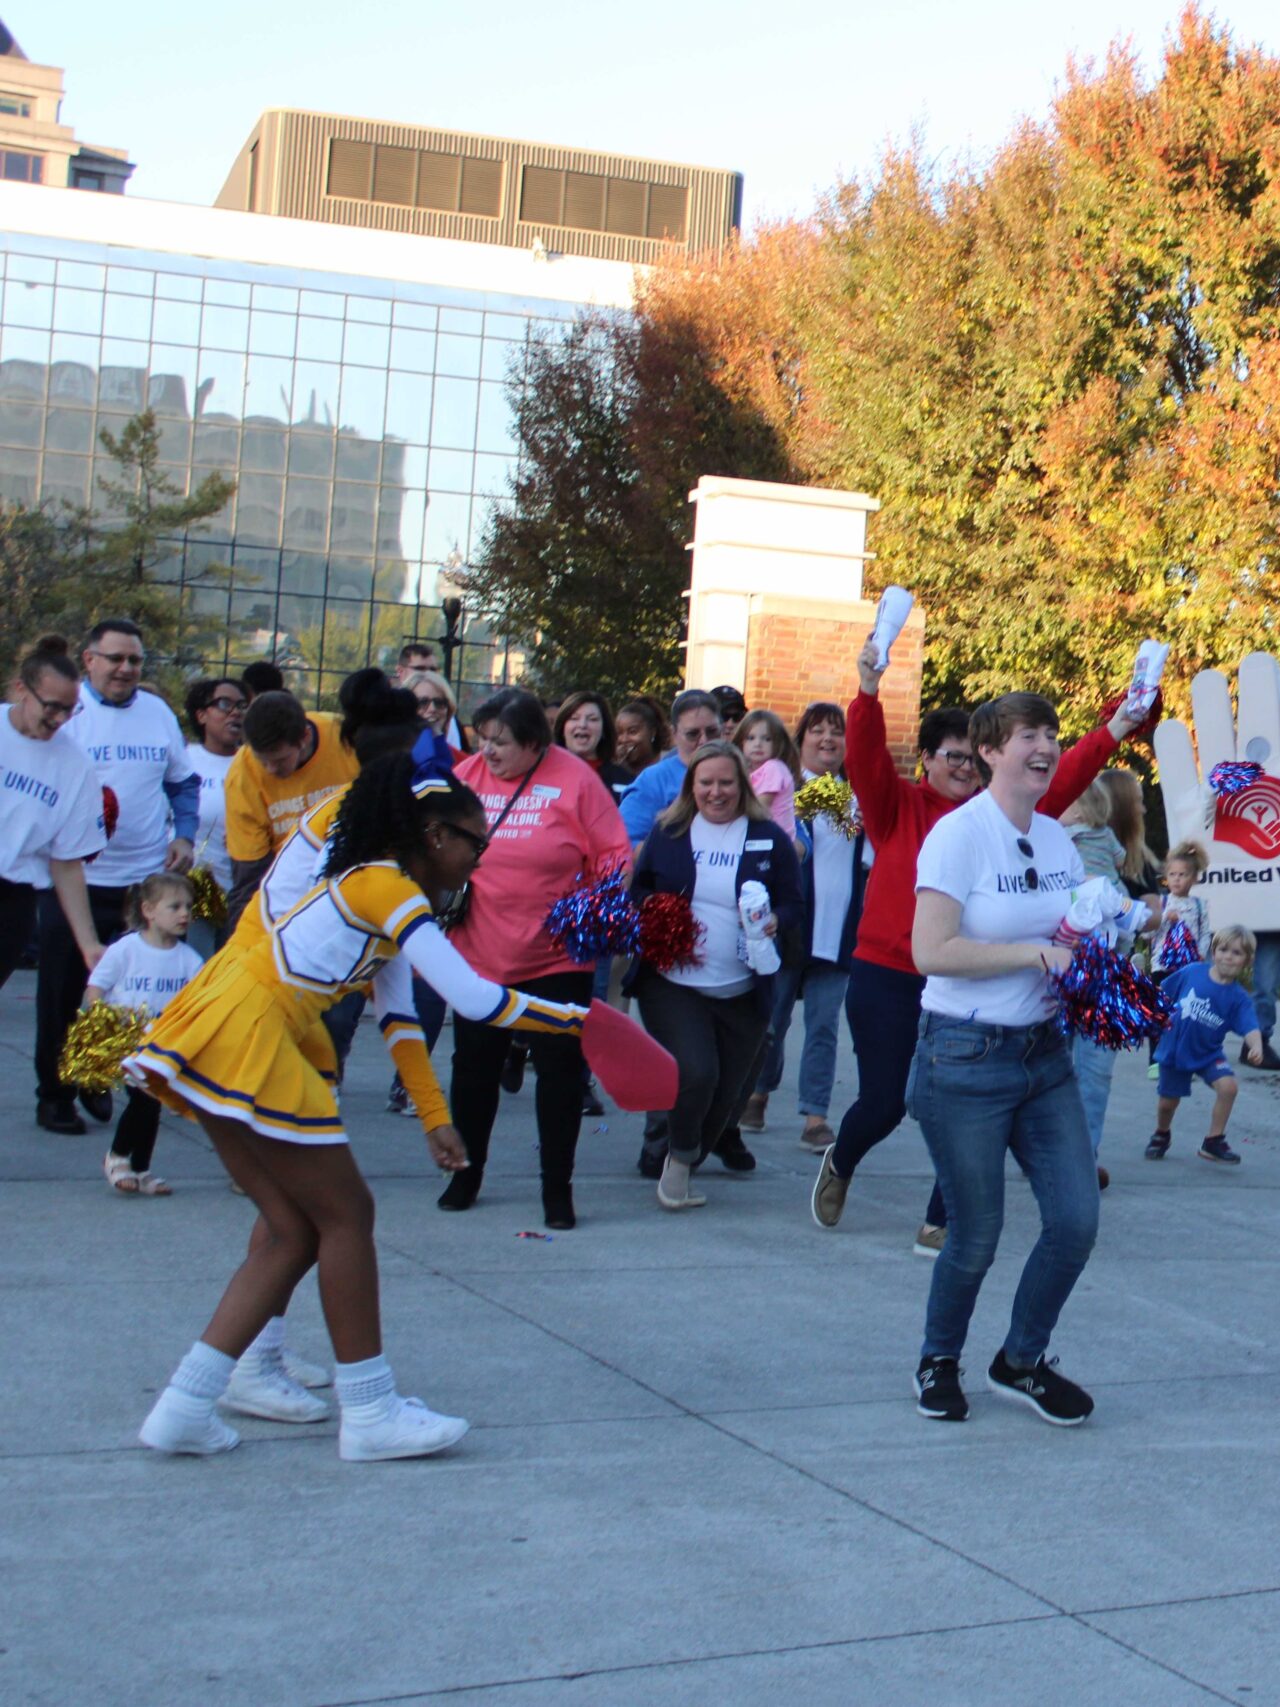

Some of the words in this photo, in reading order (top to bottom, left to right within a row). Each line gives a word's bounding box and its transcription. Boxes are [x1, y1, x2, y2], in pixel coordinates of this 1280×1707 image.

[4, 770, 60, 808] UNITED
[997, 873, 1029, 893] LIVE
[124, 976, 154, 992] LIVE
